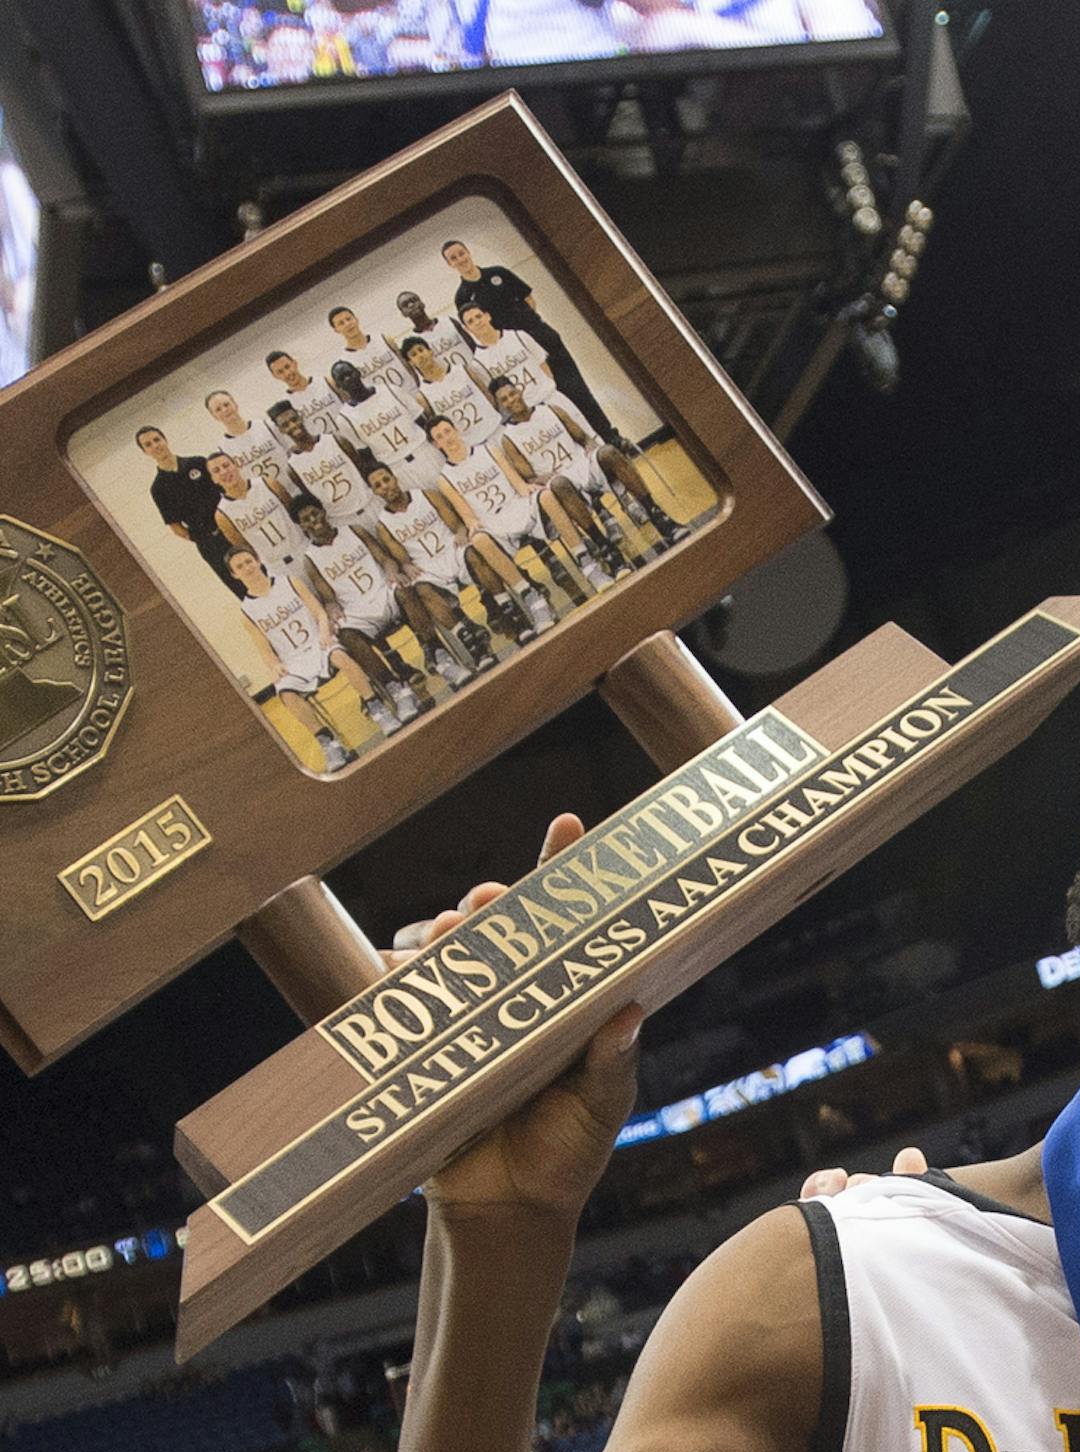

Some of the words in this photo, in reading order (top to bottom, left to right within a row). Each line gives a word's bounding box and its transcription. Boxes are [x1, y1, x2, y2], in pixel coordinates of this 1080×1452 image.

[313, 411, 340, 434] 21
[451, 402, 484, 432] 32
[382, 426, 409, 452] 14
[541, 442, 573, 472] 24
[322, 471, 352, 503] 25
[476, 484, 506, 513] 33
[259, 520, 287, 547] 11
[417, 530, 446, 559] 12
[348, 566, 374, 596] 15
[71, 573, 125, 684] LEAGUE
[281, 619, 310, 649] 13
[31, 693, 120, 784] SCHOOL
[79, 811, 192, 906] 2015
[331, 941, 499, 1073] BOYS
[472, 726, 818, 972] BASKETBALL
[345, 1025, 500, 1142] STATE
[497, 918, 648, 1030] CLASS
[644, 853, 749, 930] AAA
[738, 686, 973, 857] CHAMPION
